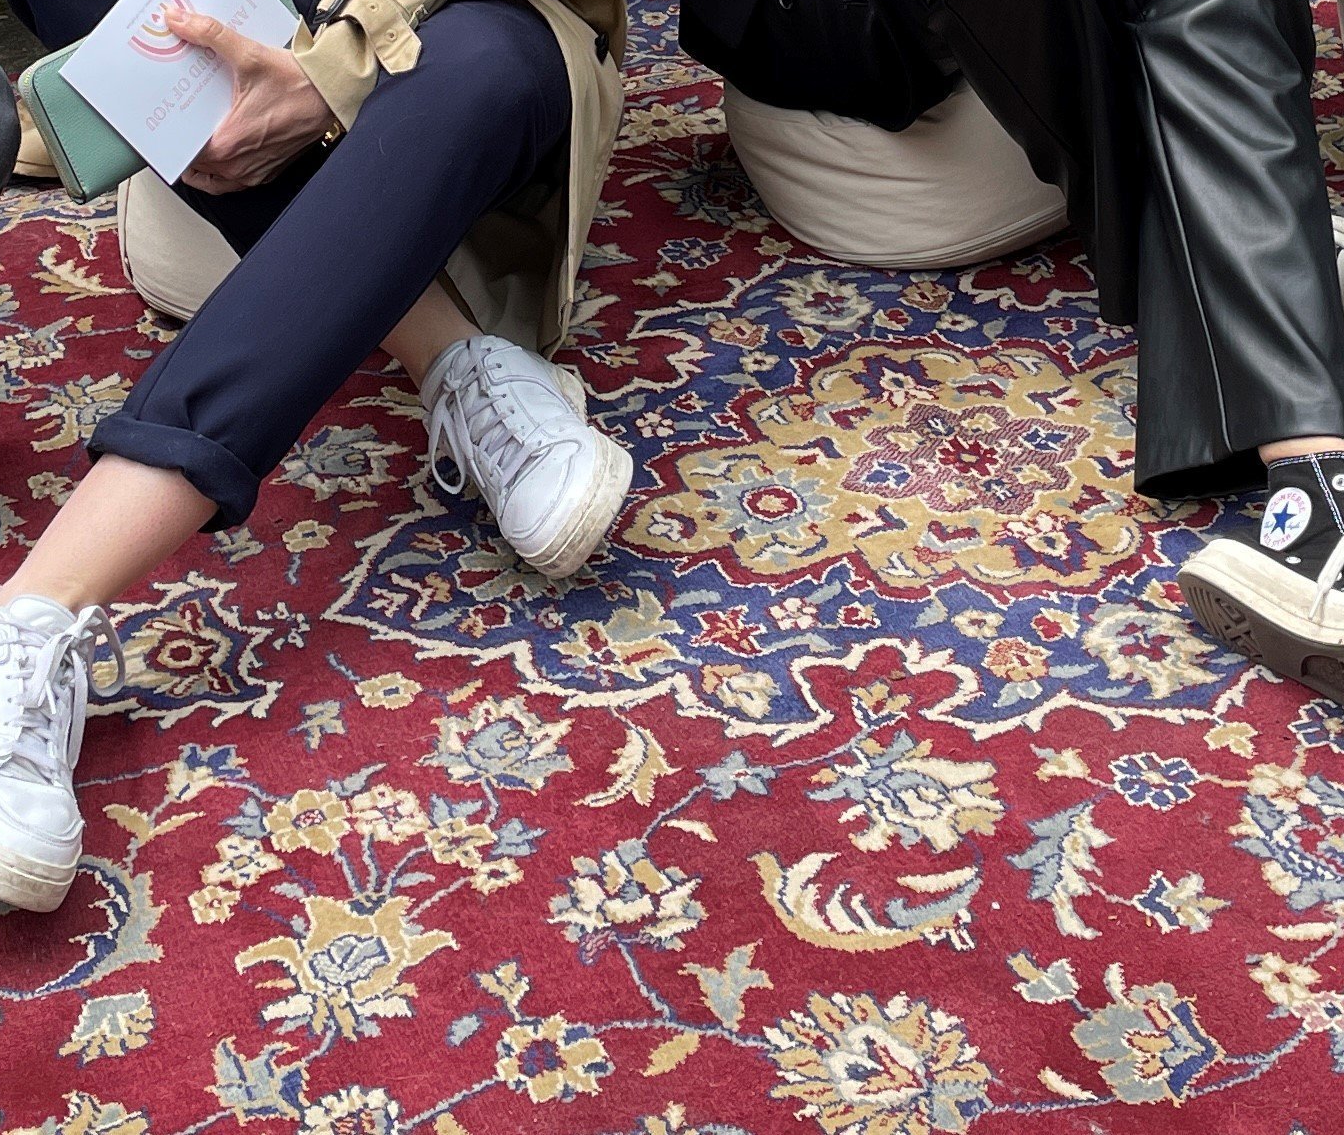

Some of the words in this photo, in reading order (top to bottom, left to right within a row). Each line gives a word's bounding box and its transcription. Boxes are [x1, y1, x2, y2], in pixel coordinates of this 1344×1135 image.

[189, 46, 217, 79] OUD
[172, 76, 191, 100] OF
[145, 97, 175, 132] YOU
